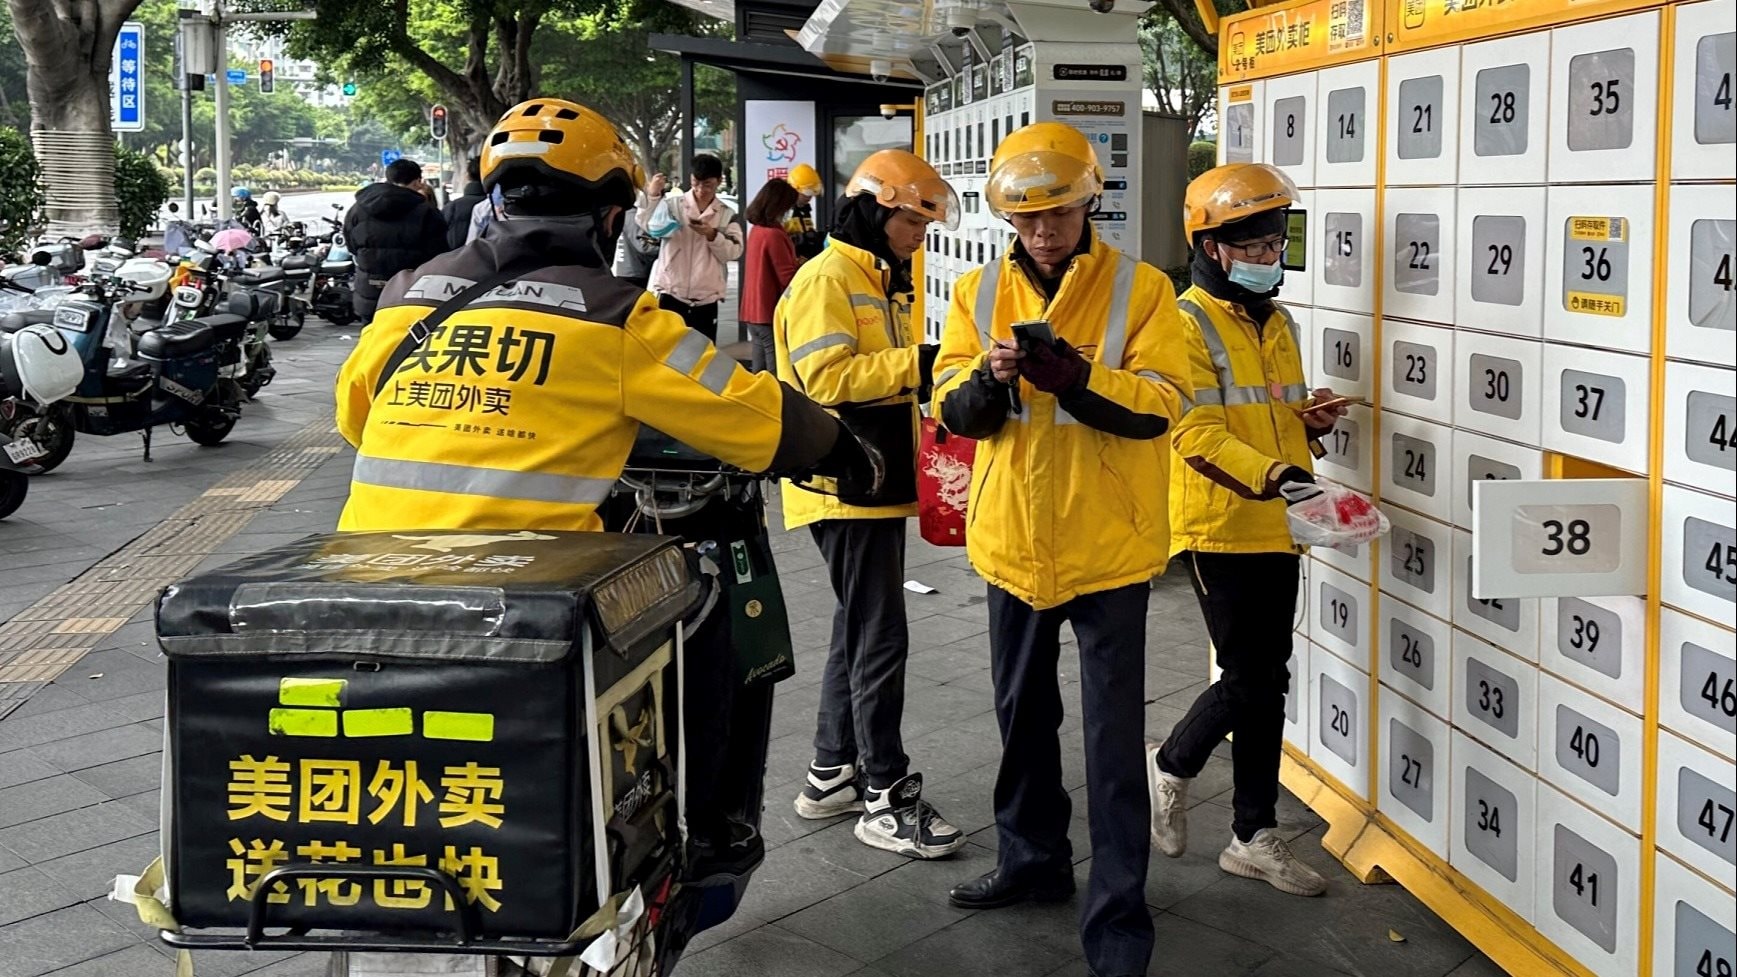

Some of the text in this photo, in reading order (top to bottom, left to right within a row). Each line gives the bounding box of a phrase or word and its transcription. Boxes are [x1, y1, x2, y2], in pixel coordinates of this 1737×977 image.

[1255, 21, 1311, 56] 美团外卖柜
[121, 59, 137, 109] 等待区
[1590, 79, 1620, 116] 35
[1714, 73, 1736, 110] 4
[1413, 104, 1432, 133] 21
[1490, 92, 1515, 124] 28
[1286, 114, 1295, 138] 8
[1338, 113, 1355, 139] 14
[1336, 231, 1353, 257] 15
[1409, 241, 1430, 270] 22
[1488, 244, 1512, 276] 29
[1581, 246, 1612, 282] 36
[1714, 253, 1736, 291] 4
[1335, 340, 1353, 368] 16
[1406, 354, 1426, 384] 23
[387, 380, 512, 416] 上美团外卖
[1485, 369, 1510, 402] 30
[1574, 384, 1605, 421] 37
[1333, 428, 1350, 456] 17
[1405, 449, 1426, 481] 24
[1541, 519, 1591, 556] 38
[1404, 543, 1425, 576] 25
[1331, 599, 1348, 628] 19
[1401, 634, 1421, 668] 26
[1570, 615, 1600, 653] 39
[1478, 680, 1504, 719] 33
[1701, 672, 1736, 717] 46
[1331, 704, 1349, 737] 20
[1569, 726, 1600, 768] 40
[1401, 754, 1421, 788] 27
[227, 755, 504, 828] 美团外卖
[1478, 799, 1501, 838] 34
[1698, 799, 1735, 843] 47
[226, 838, 503, 913] 送花也快
[1569, 863, 1598, 907] 41
